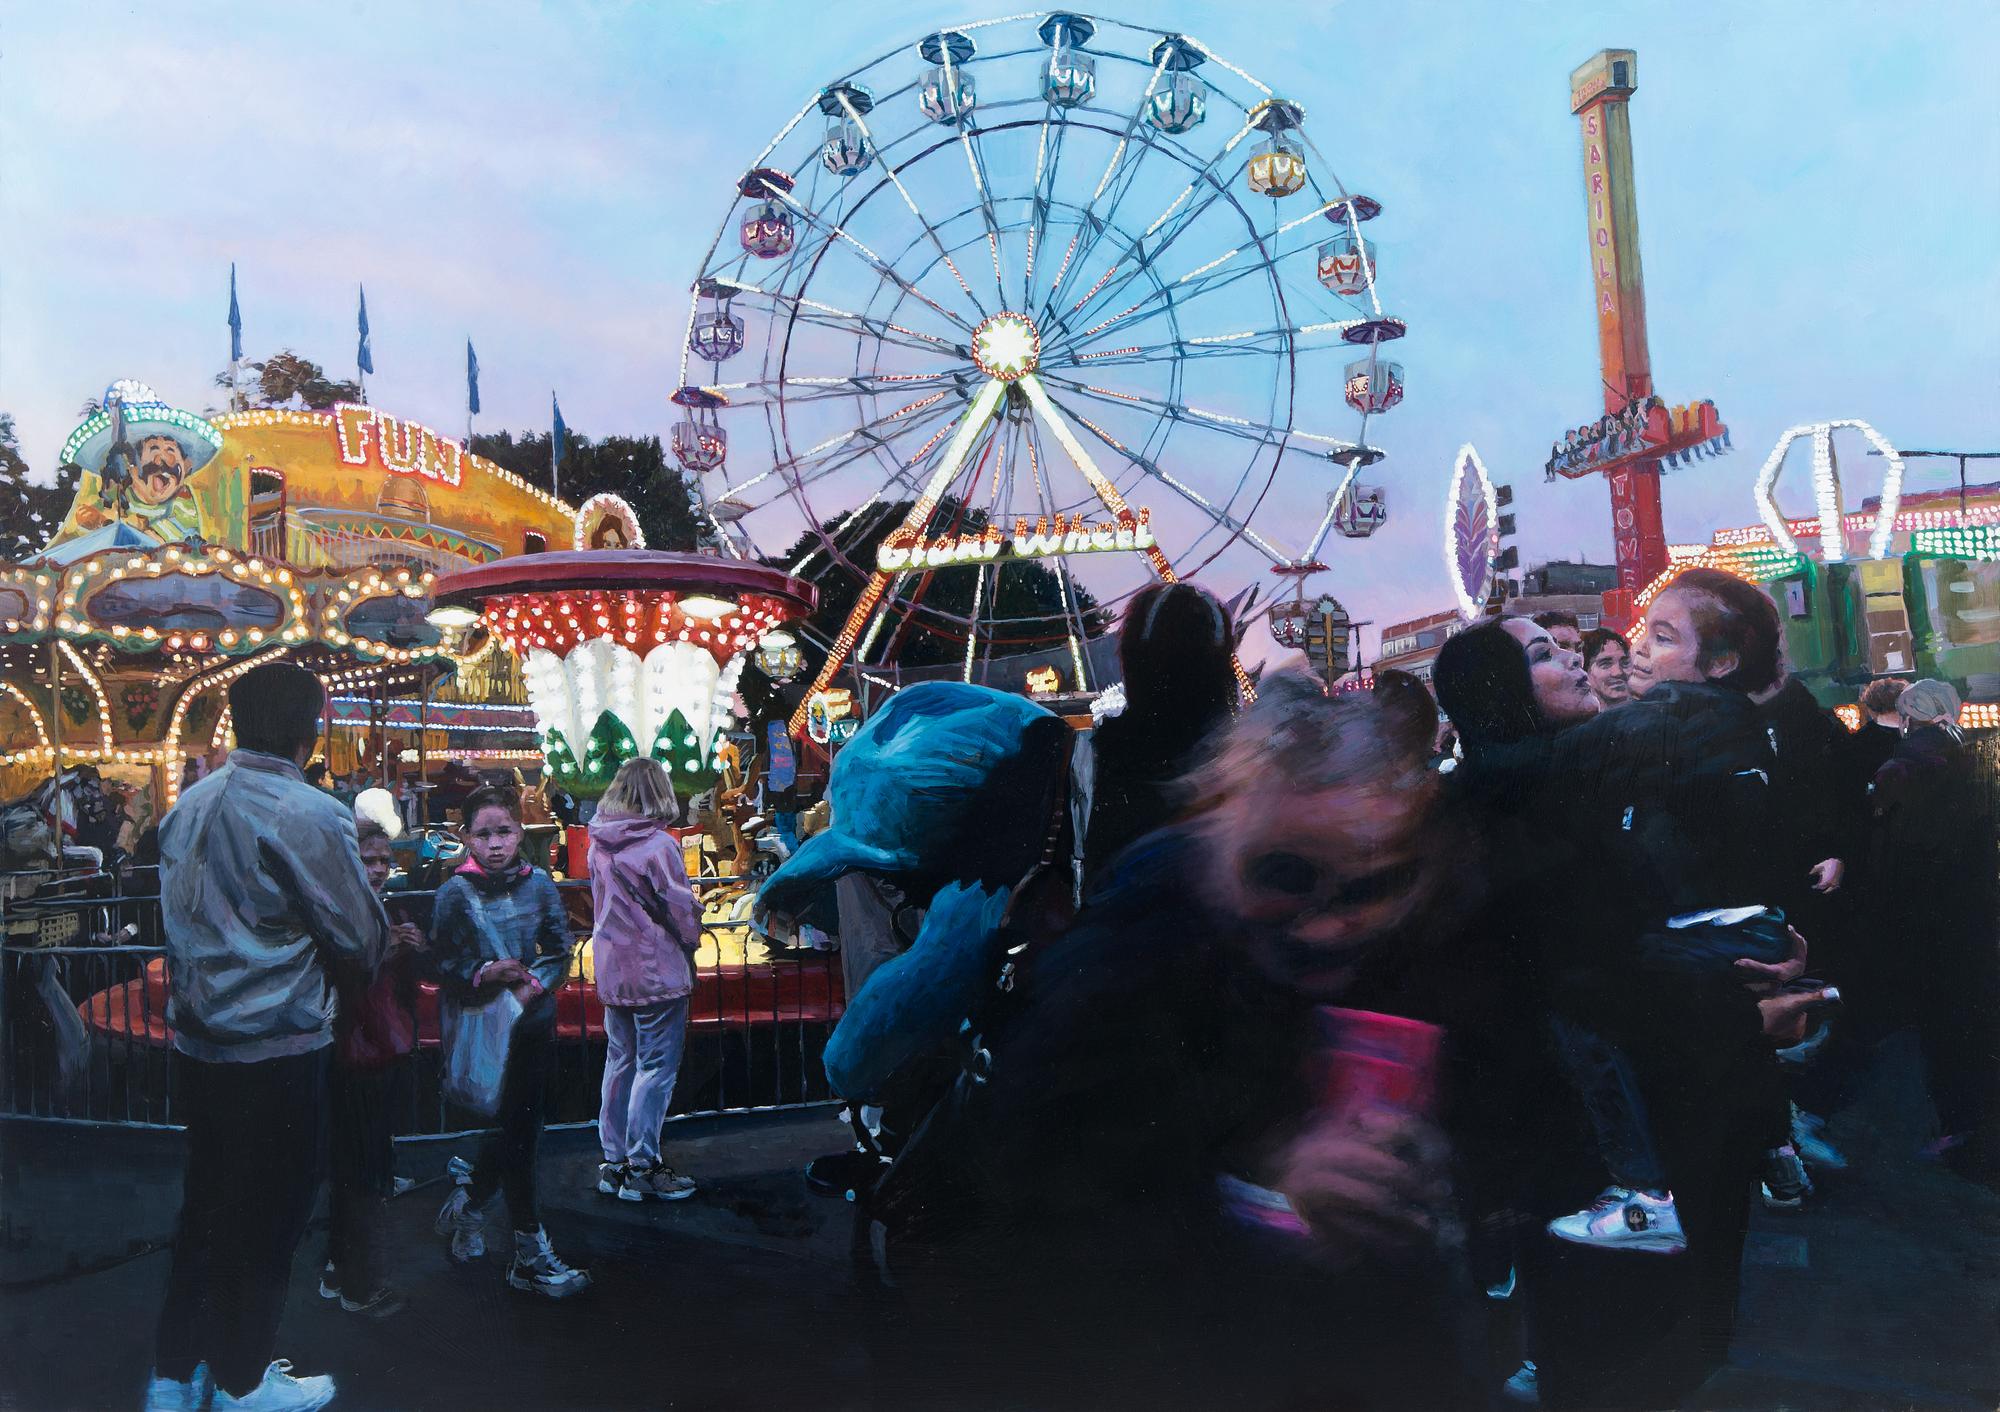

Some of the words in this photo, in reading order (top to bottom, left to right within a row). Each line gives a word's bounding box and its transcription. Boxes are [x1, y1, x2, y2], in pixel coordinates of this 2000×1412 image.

[1586, 113, 1615, 316] SARIOLA
[334, 402, 463, 487] FUN
[877, 523, 1004, 570] Giant
[1013, 506, 1156, 558] Wheel
